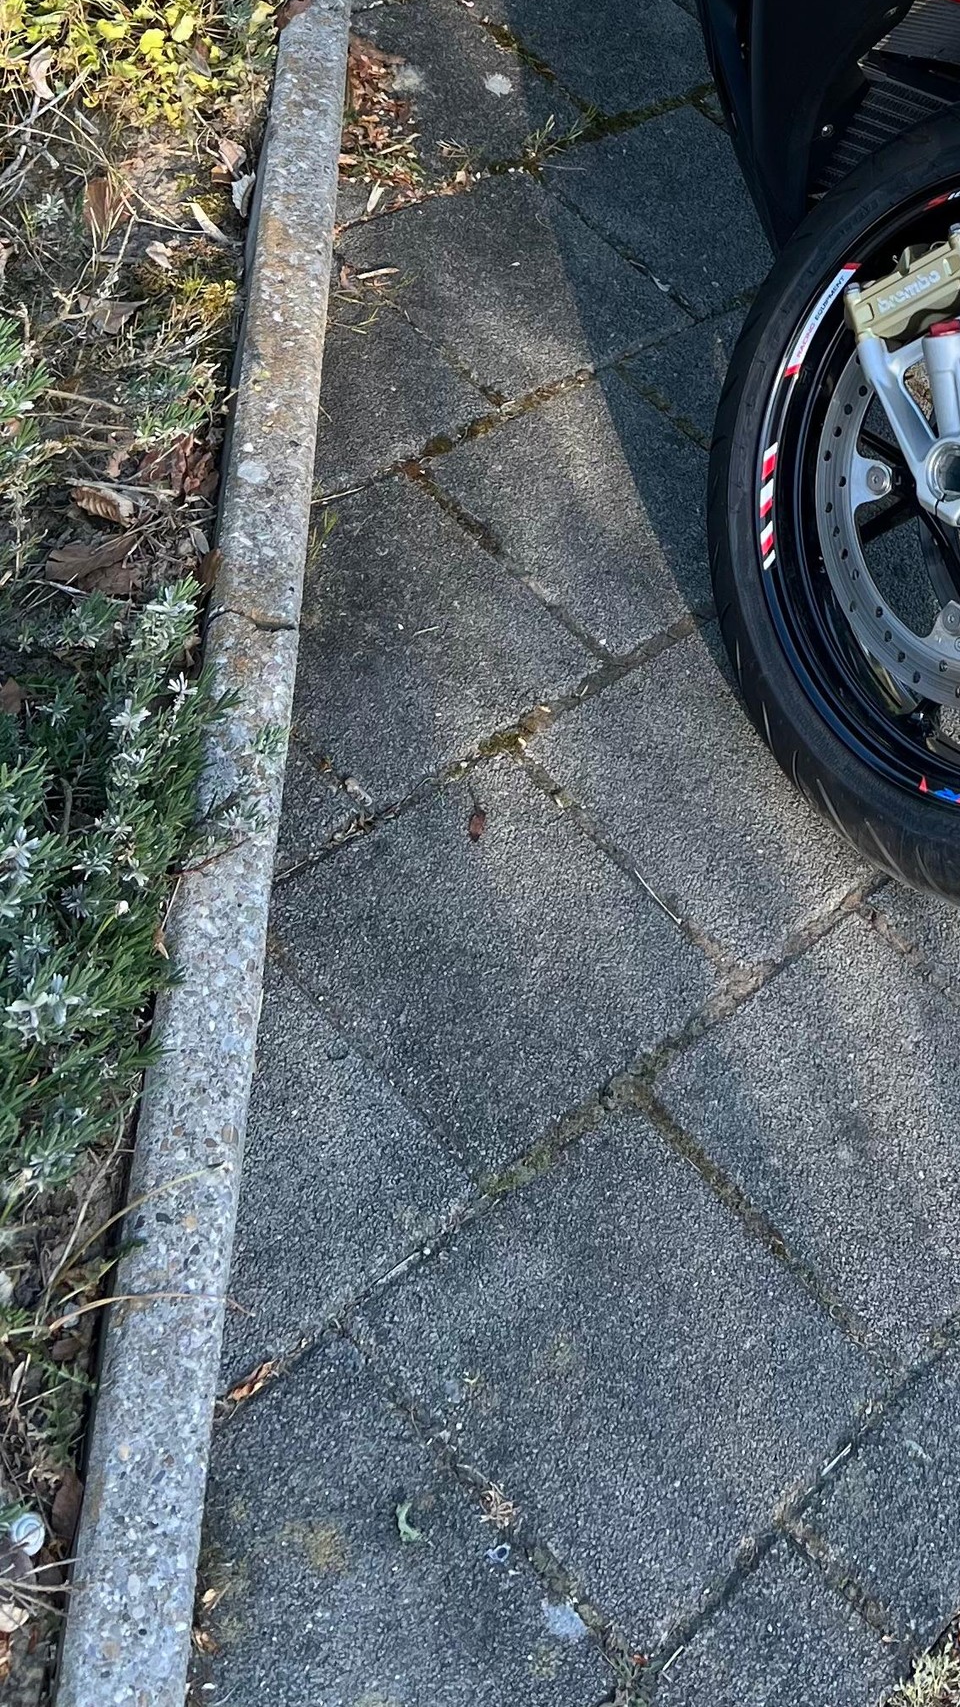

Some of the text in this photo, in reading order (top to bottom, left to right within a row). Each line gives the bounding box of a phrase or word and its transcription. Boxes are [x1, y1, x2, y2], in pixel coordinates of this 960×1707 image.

[797, 275, 846, 358] RACING EQUIPMENT
[877, 269, 941, 315] brembo
